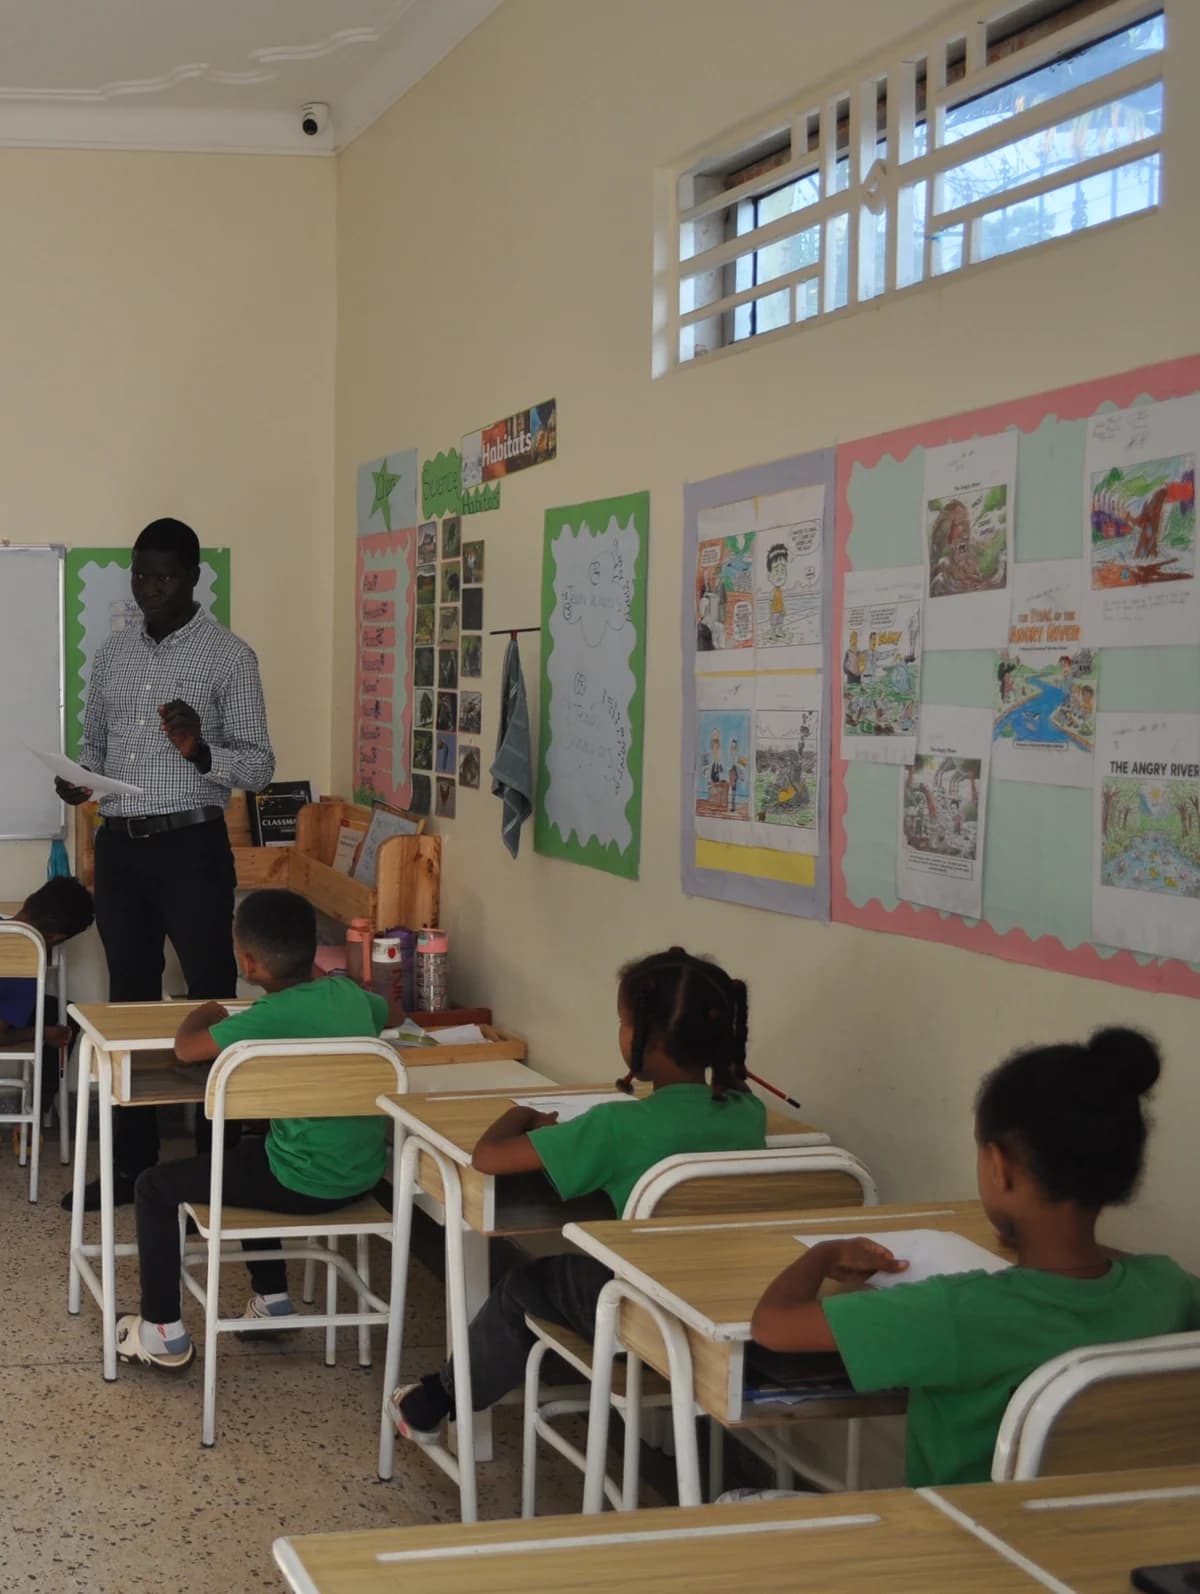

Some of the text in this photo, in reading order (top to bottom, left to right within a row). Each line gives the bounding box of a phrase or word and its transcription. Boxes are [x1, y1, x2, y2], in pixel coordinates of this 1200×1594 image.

[481, 432, 532, 468] Habitats
[1110, 760, 1200, 778] THE ANGRY RIVER
